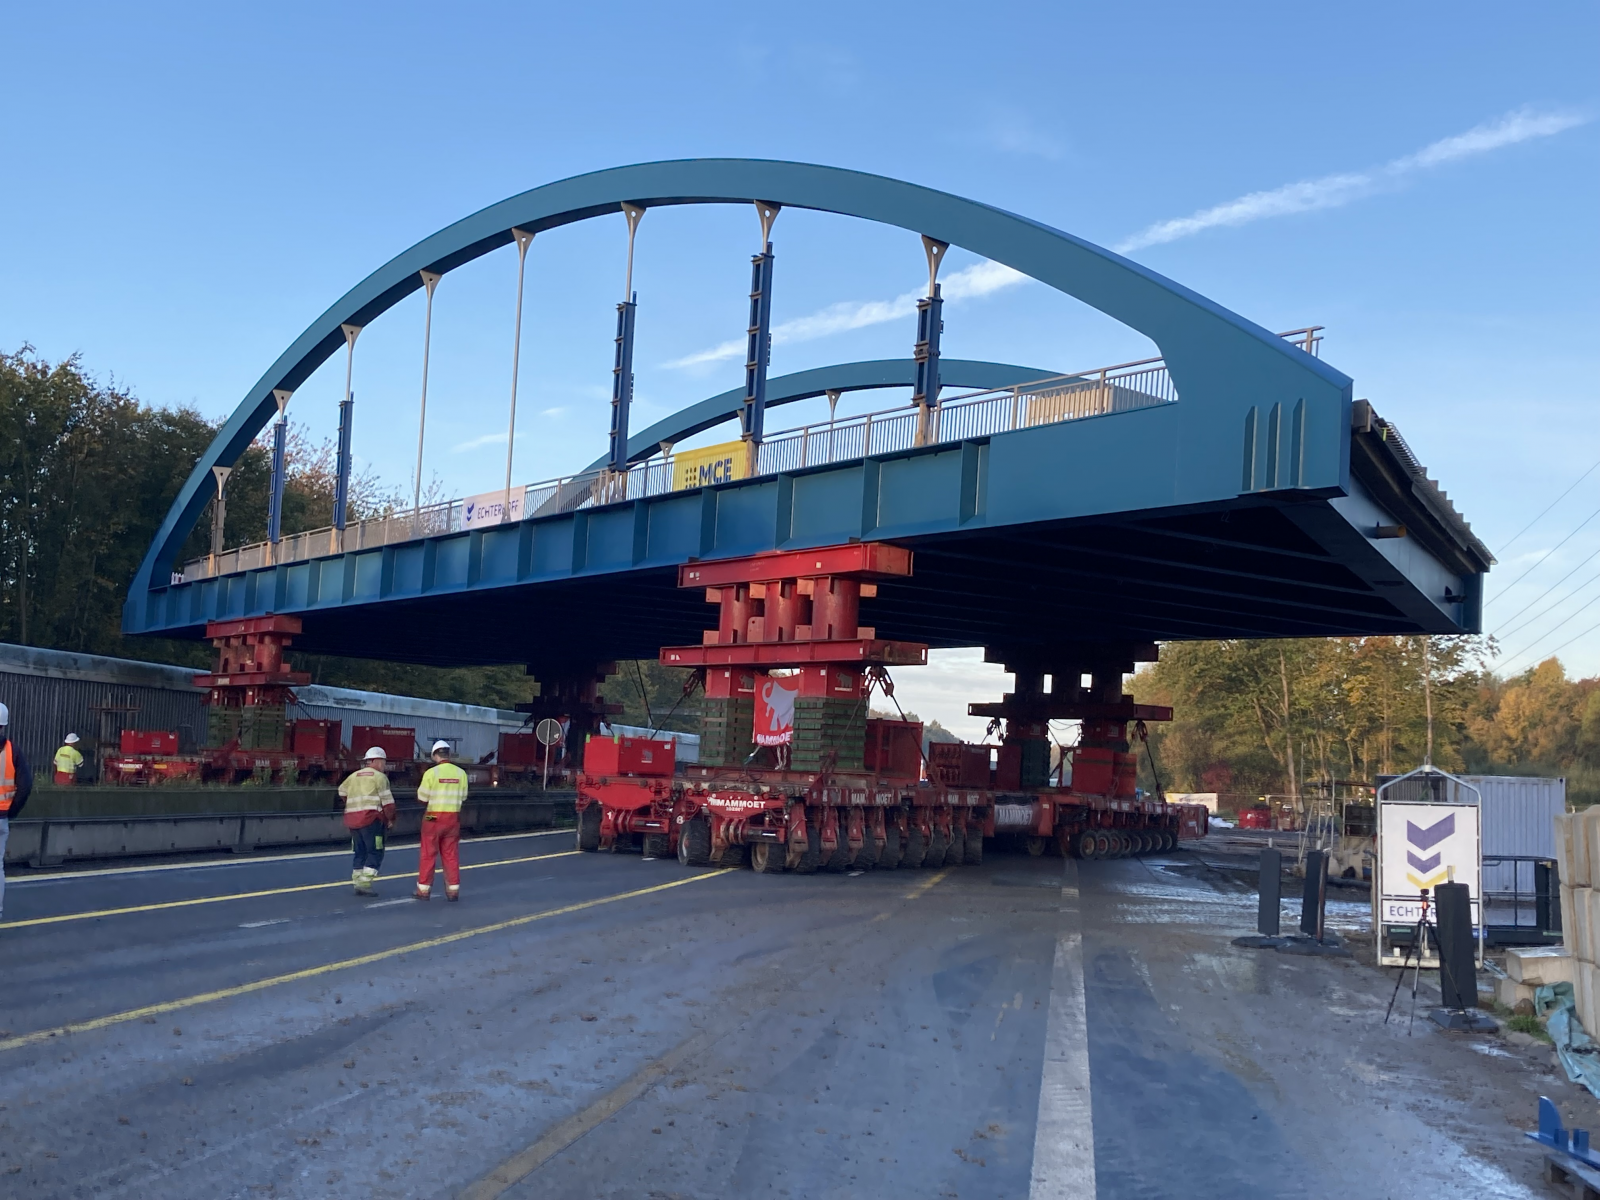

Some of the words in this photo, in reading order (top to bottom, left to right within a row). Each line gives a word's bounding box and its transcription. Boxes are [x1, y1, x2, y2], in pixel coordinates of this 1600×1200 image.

[699, 458, 732, 486] MCE
[477, 499, 519, 519] ECHTEROFF
[717, 799, 766, 809] MAMMOET
[1389, 905, 1437, 918] ECHTR
